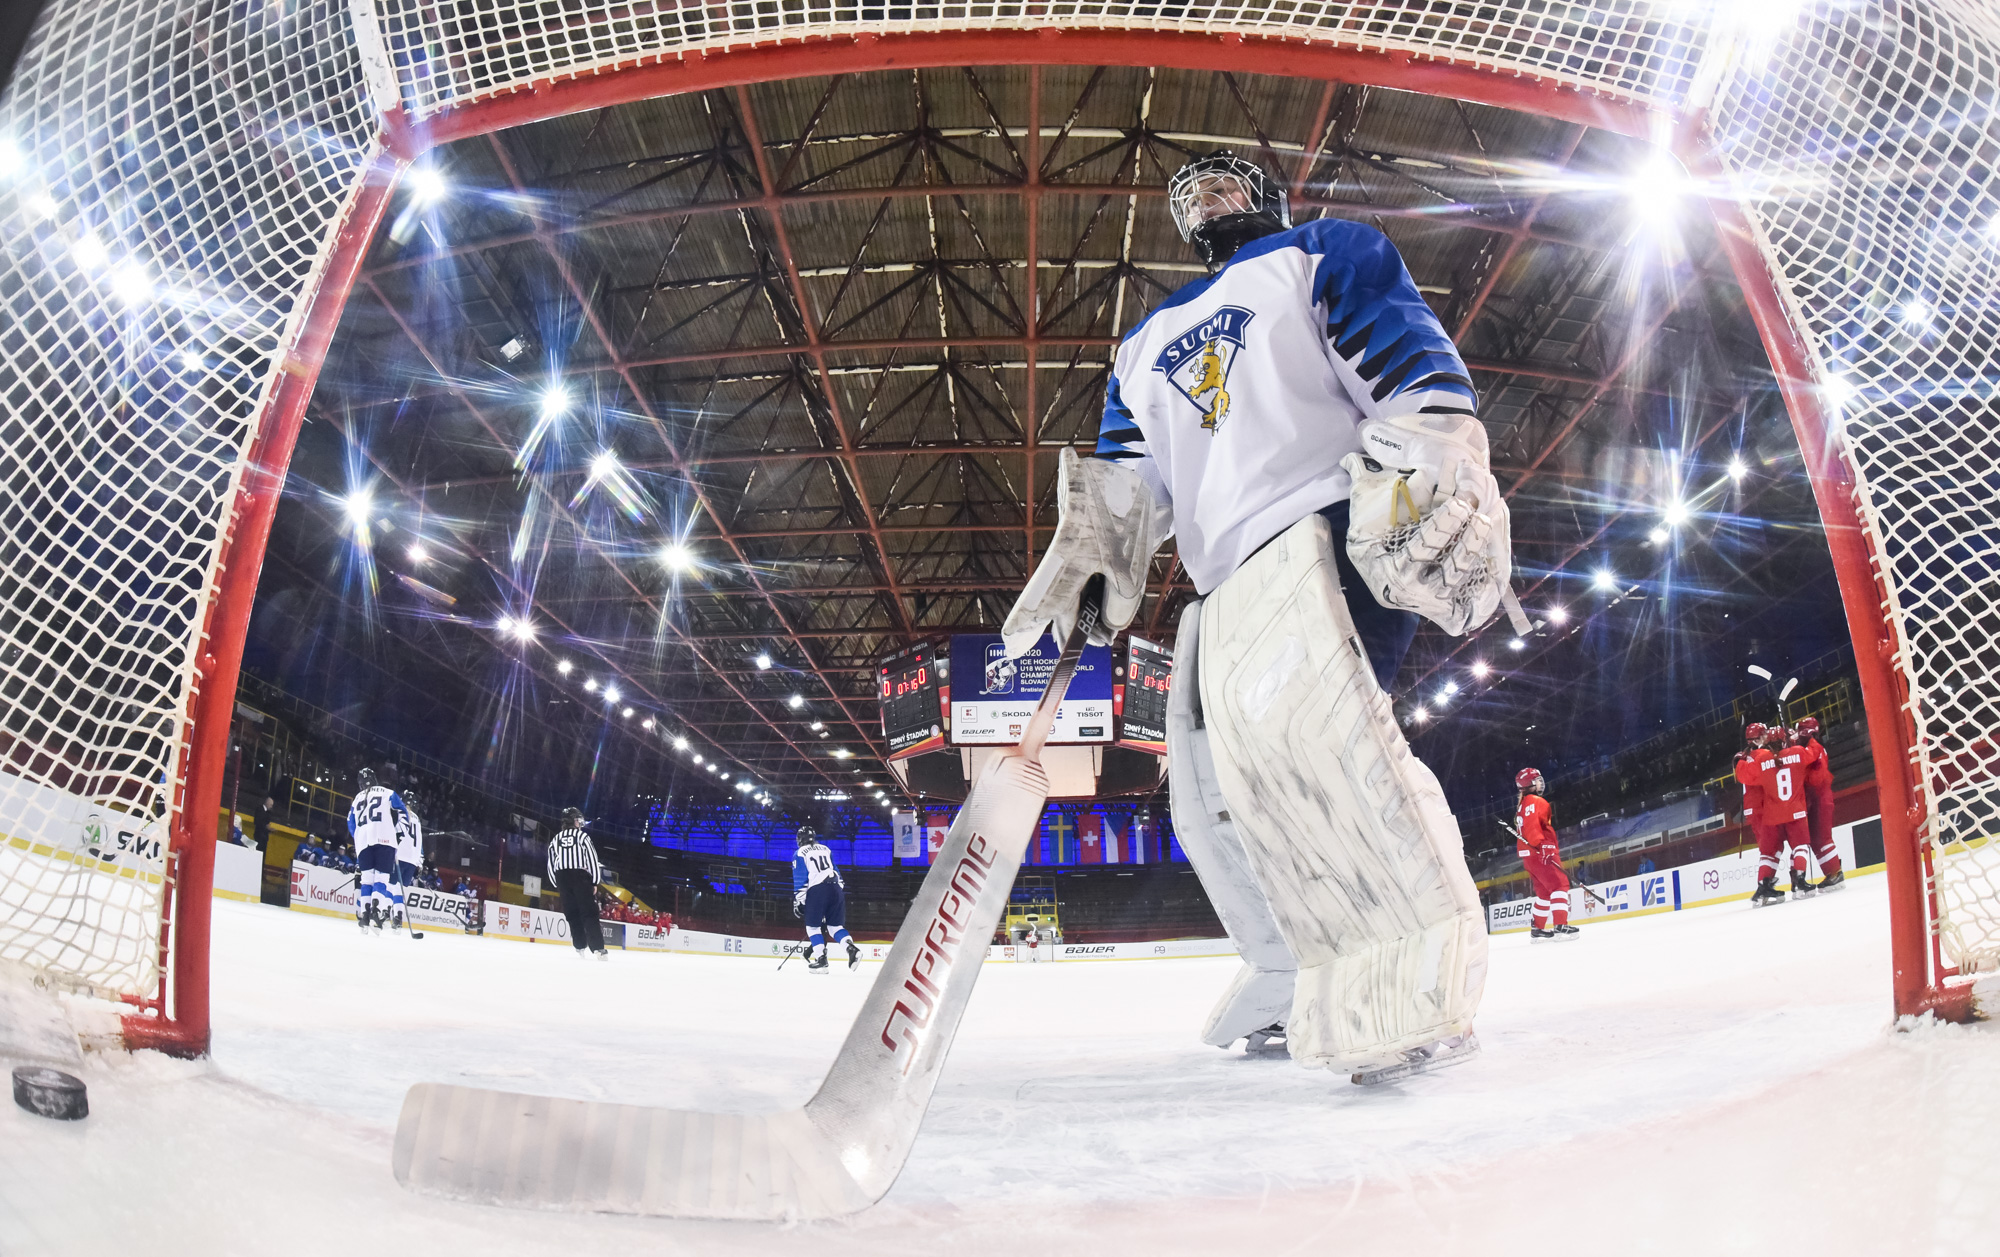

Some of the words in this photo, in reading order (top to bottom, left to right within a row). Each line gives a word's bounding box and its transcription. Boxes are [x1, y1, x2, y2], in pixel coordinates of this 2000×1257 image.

[1166, 313, 1232, 362] SUOMI
[1077, 597, 1099, 635] BAU
[918, 667, 926, 685] 0
[1129, 663, 1138, 680] 0
[883, 680, 891, 697] 0
[1776, 768, 1793, 802] 8
[356, 796, 382, 827] 22
[1524, 803, 1536, 817] 24
[561, 836, 574, 848] 59
[810, 855, 830, 873] 14
[310, 884, 354, 906] Kaufland
[881, 832, 997, 1077] SUPREME
